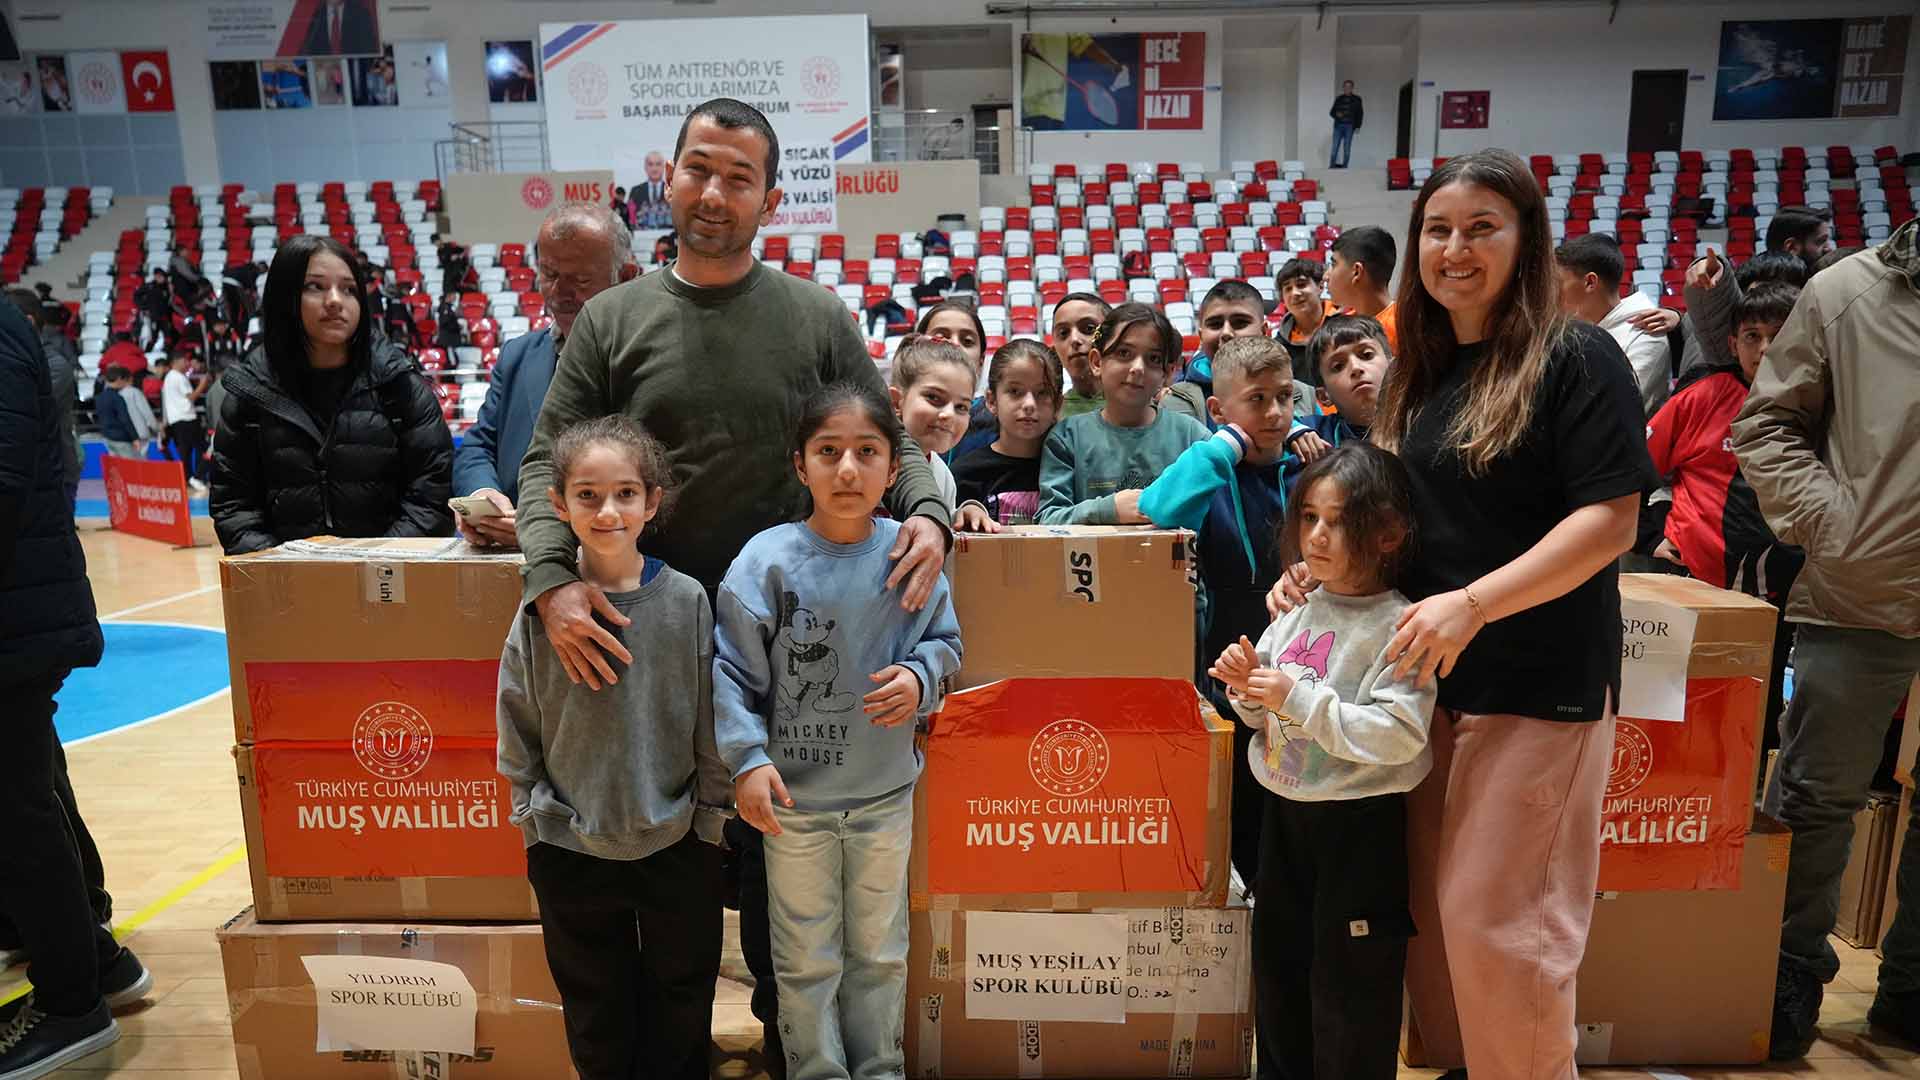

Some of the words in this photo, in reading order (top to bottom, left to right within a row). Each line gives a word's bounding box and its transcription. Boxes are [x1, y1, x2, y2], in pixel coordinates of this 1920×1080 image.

[624, 61, 663, 81] TÜM
[668, 60, 762, 79] ANTRENÖR
[765, 60, 785, 77] VE
[630, 79, 780, 99] SPORCULARIMIZA
[756, 101, 790, 114] RUM
[785, 147, 830, 161] SICAK
[790, 166, 831, 181] YÜZÜ
[794, 187, 833, 204] VALİSİ
[1622, 618, 1669, 637] SPOR
[1622, 642, 1645, 660] BÜ
[778, 724, 849, 739] MICKEY
[784, 747, 844, 766] MOUSE
[295, 778, 368, 798] TÜRKİYE
[373, 778, 498, 798] CUMHURİYETİ
[966, 796, 1041, 816] TÜRKİYE
[1045, 795, 1170, 815] CUMHURİYETİ
[1601, 795, 1712, 814] UMHURİYETİ
[297, 804, 366, 835] MUŞ
[374, 800, 498, 829] VALİLİĞİ
[965, 821, 1035, 852] MUŞ
[1041, 816, 1168, 845] VALİLİĞİ
[1600, 815, 1708, 844] ALİLİĞİ
[1210, 919, 1238, 935] Ltd.
[1127, 942, 1160, 956] nbul
[976, 953, 1022, 972] MUŞ
[1029, 951, 1122, 973] YEŞİLAY
[1127, 964, 1143, 977] de
[348, 972, 437, 987] YILDIRIM
[972, 977, 1028, 994] SPOR
[1035, 977, 1123, 996] KULÜBÜ
[331, 990, 378, 1005] SPOR
[383, 990, 462, 1008] KULÜBÜ
[1127, 985, 1148, 998] O.:
